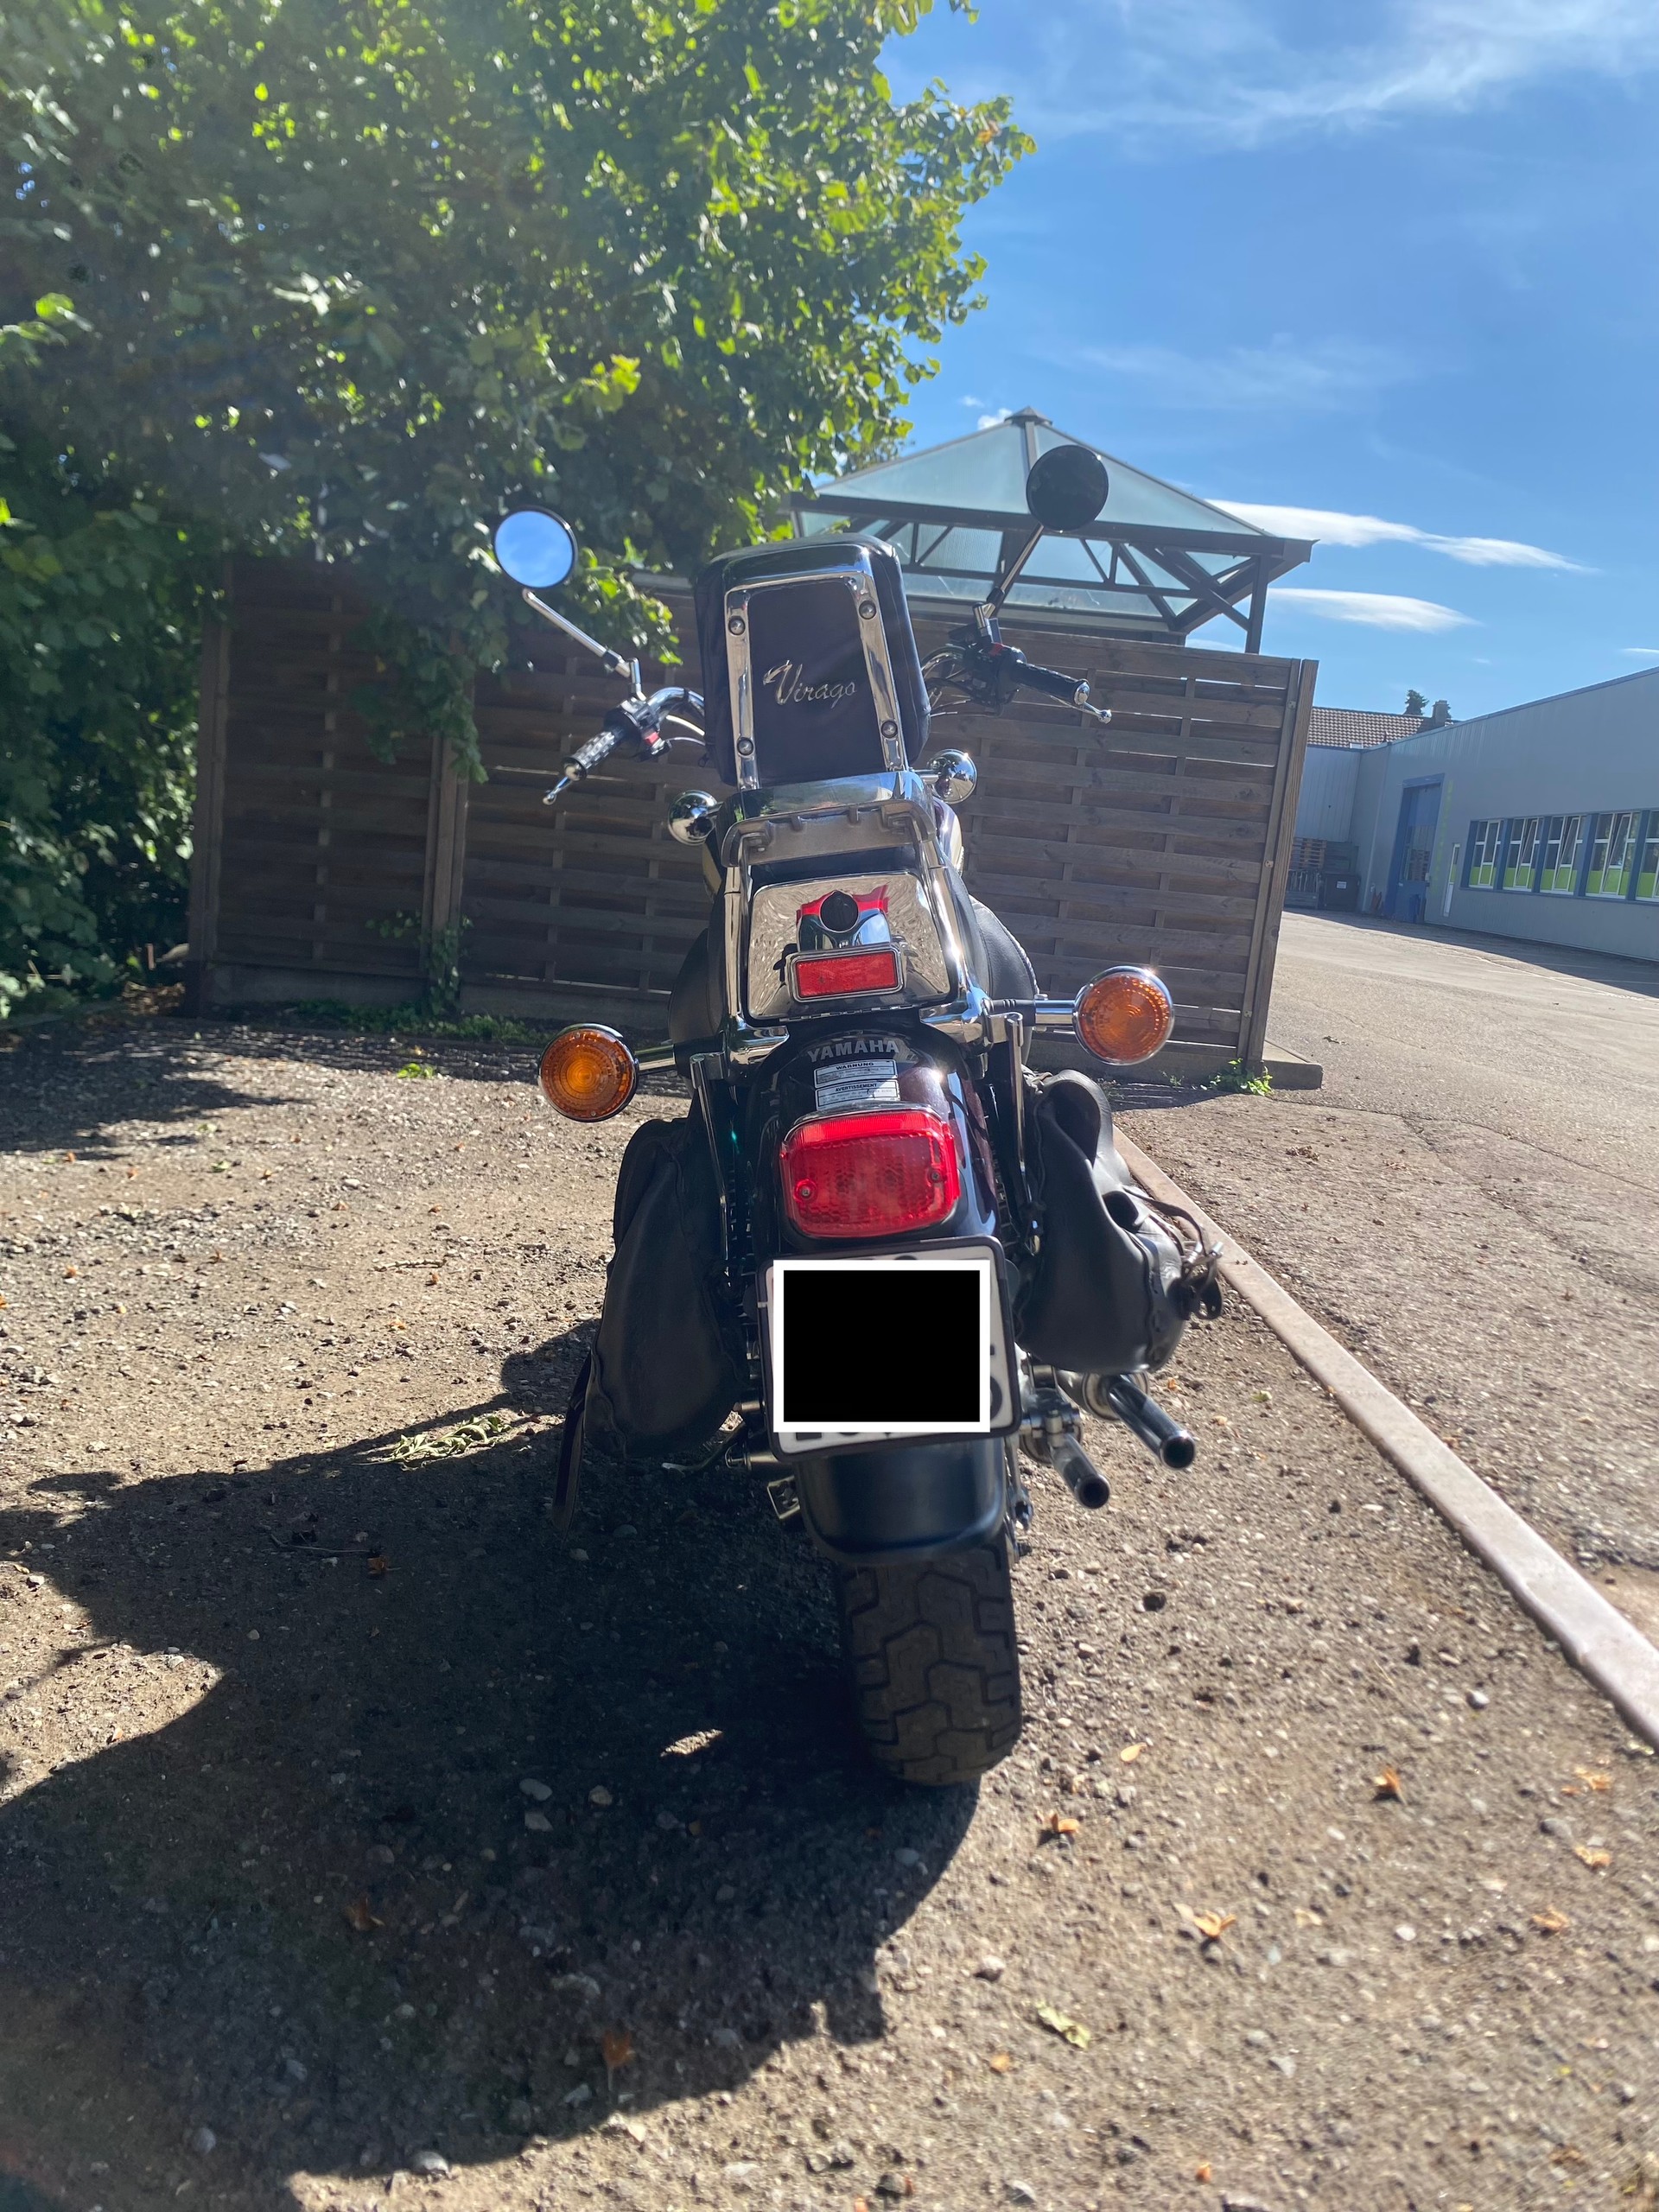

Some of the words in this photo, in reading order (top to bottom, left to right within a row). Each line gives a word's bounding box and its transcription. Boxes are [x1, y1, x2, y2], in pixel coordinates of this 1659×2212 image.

[763, 659, 855, 709] Virago
[807, 1039, 899, 1063] YAMAHA
[836, 1062, 874, 1071] WARNUNG
[835, 1083, 877, 1092] AVERTISSEMENT
